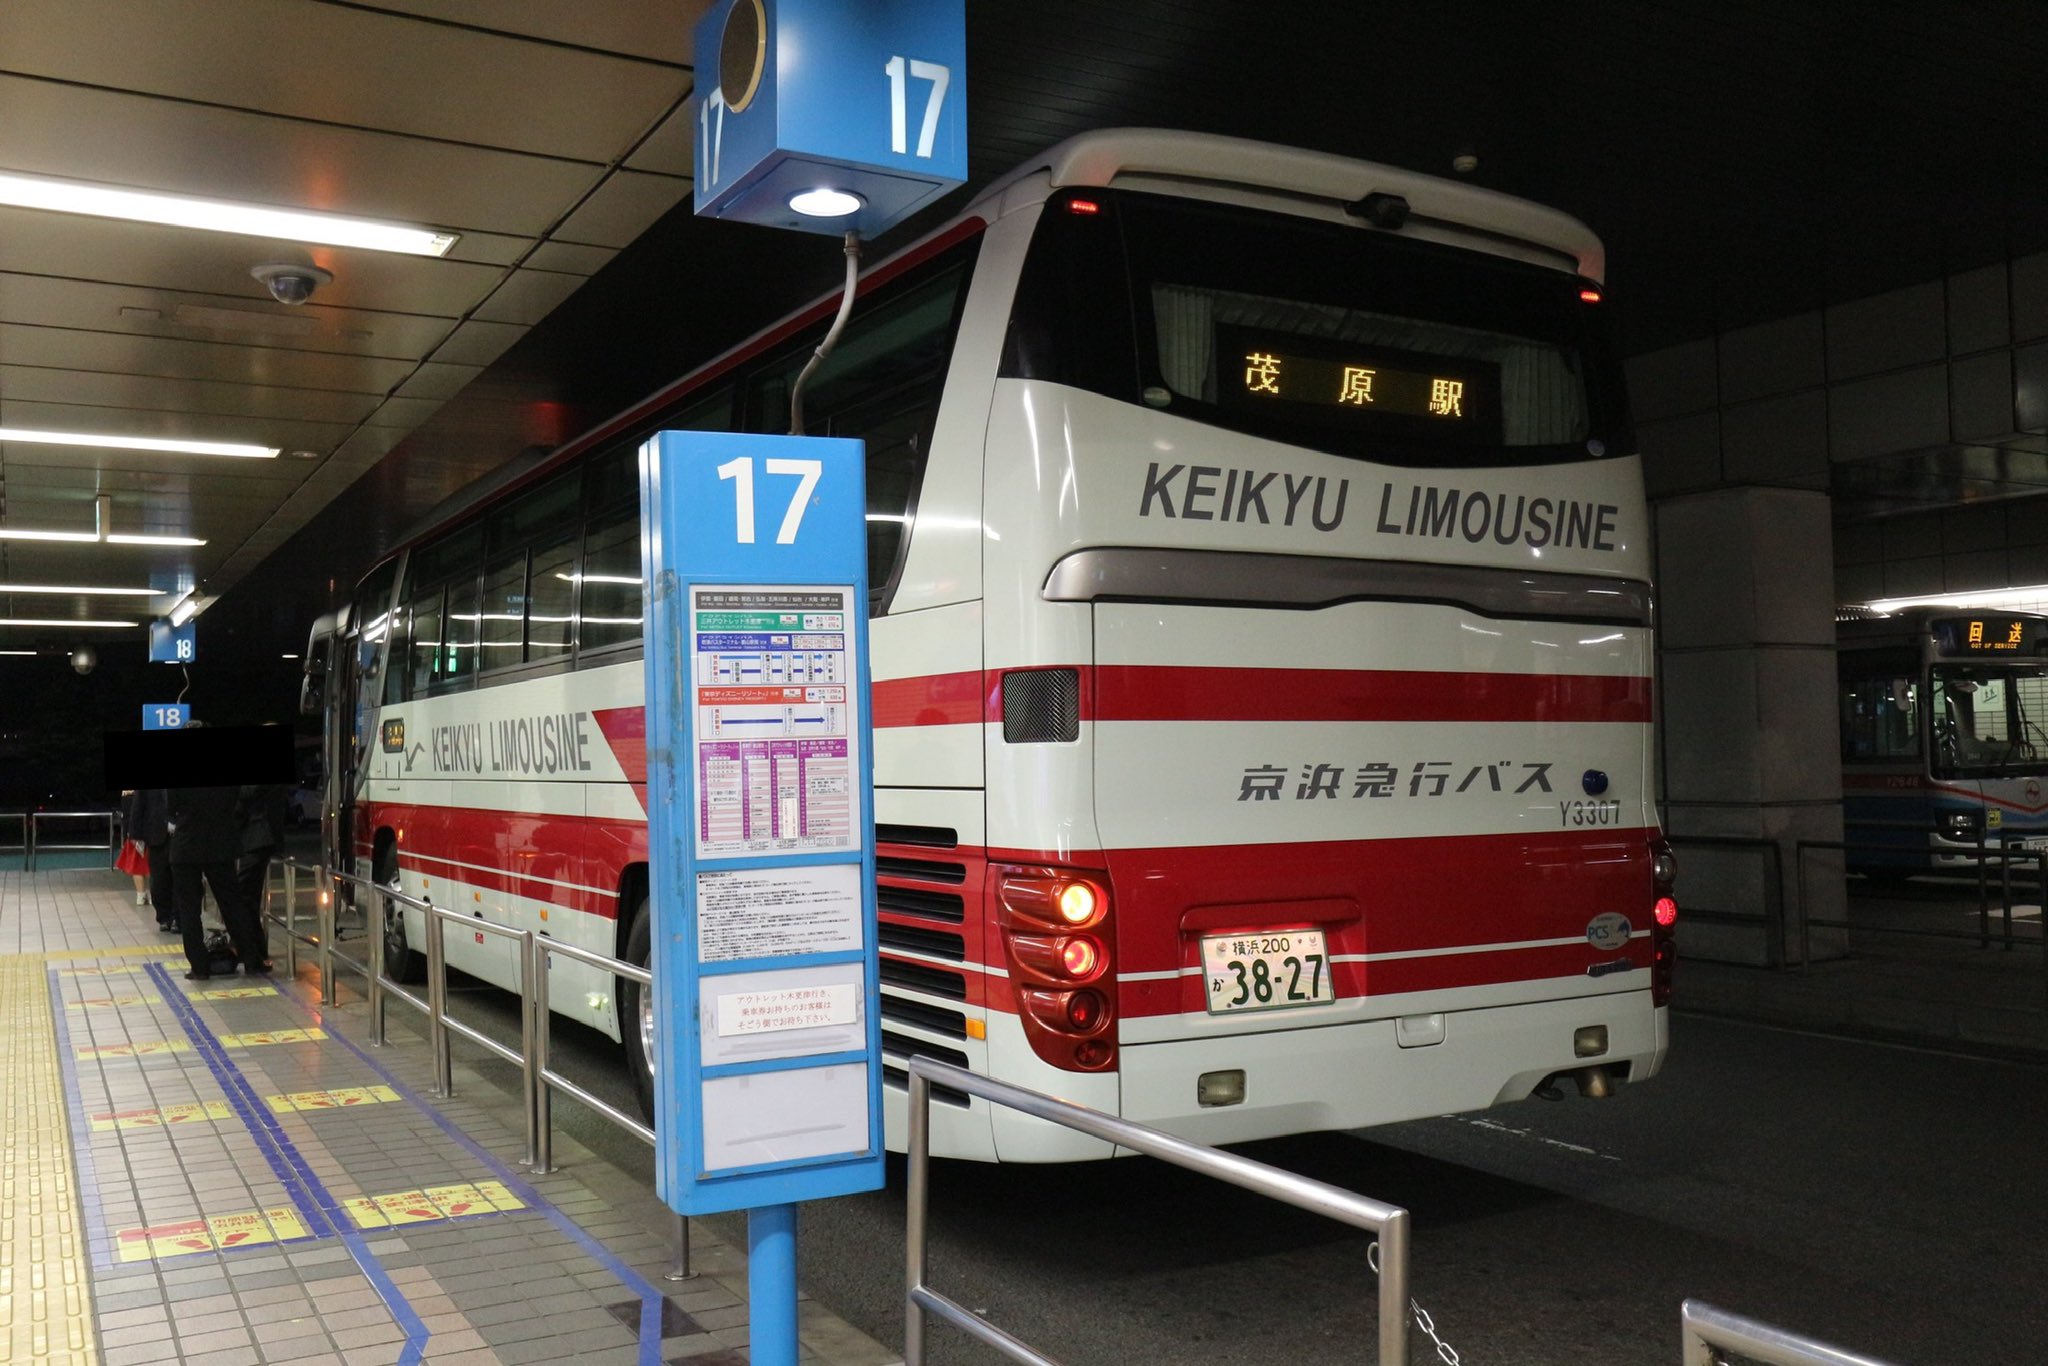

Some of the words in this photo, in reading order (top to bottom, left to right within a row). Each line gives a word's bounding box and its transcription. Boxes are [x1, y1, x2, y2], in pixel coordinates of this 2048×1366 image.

[885, 55, 950, 159] 17
[700, 86, 725, 193] 17
[1244, 352, 1464, 417] 茂原駅
[717, 456, 823, 545] 17
[1139, 461, 1349, 532] KEIKYU
[1376, 483, 1619, 551] LIMOUSINE
[176, 639, 192, 659] 18
[1968, 621, 2023, 643] 回送
[155, 708, 181, 727] 18
[431, 723, 483, 774] KEIKYU
[489, 711, 591, 774] LIMOUSINE
[1237, 760, 1555, 802] 京浜急行バス
[1560, 800, 1621, 827] Y3307
[1227, 954, 1323, 1005] 38-27
